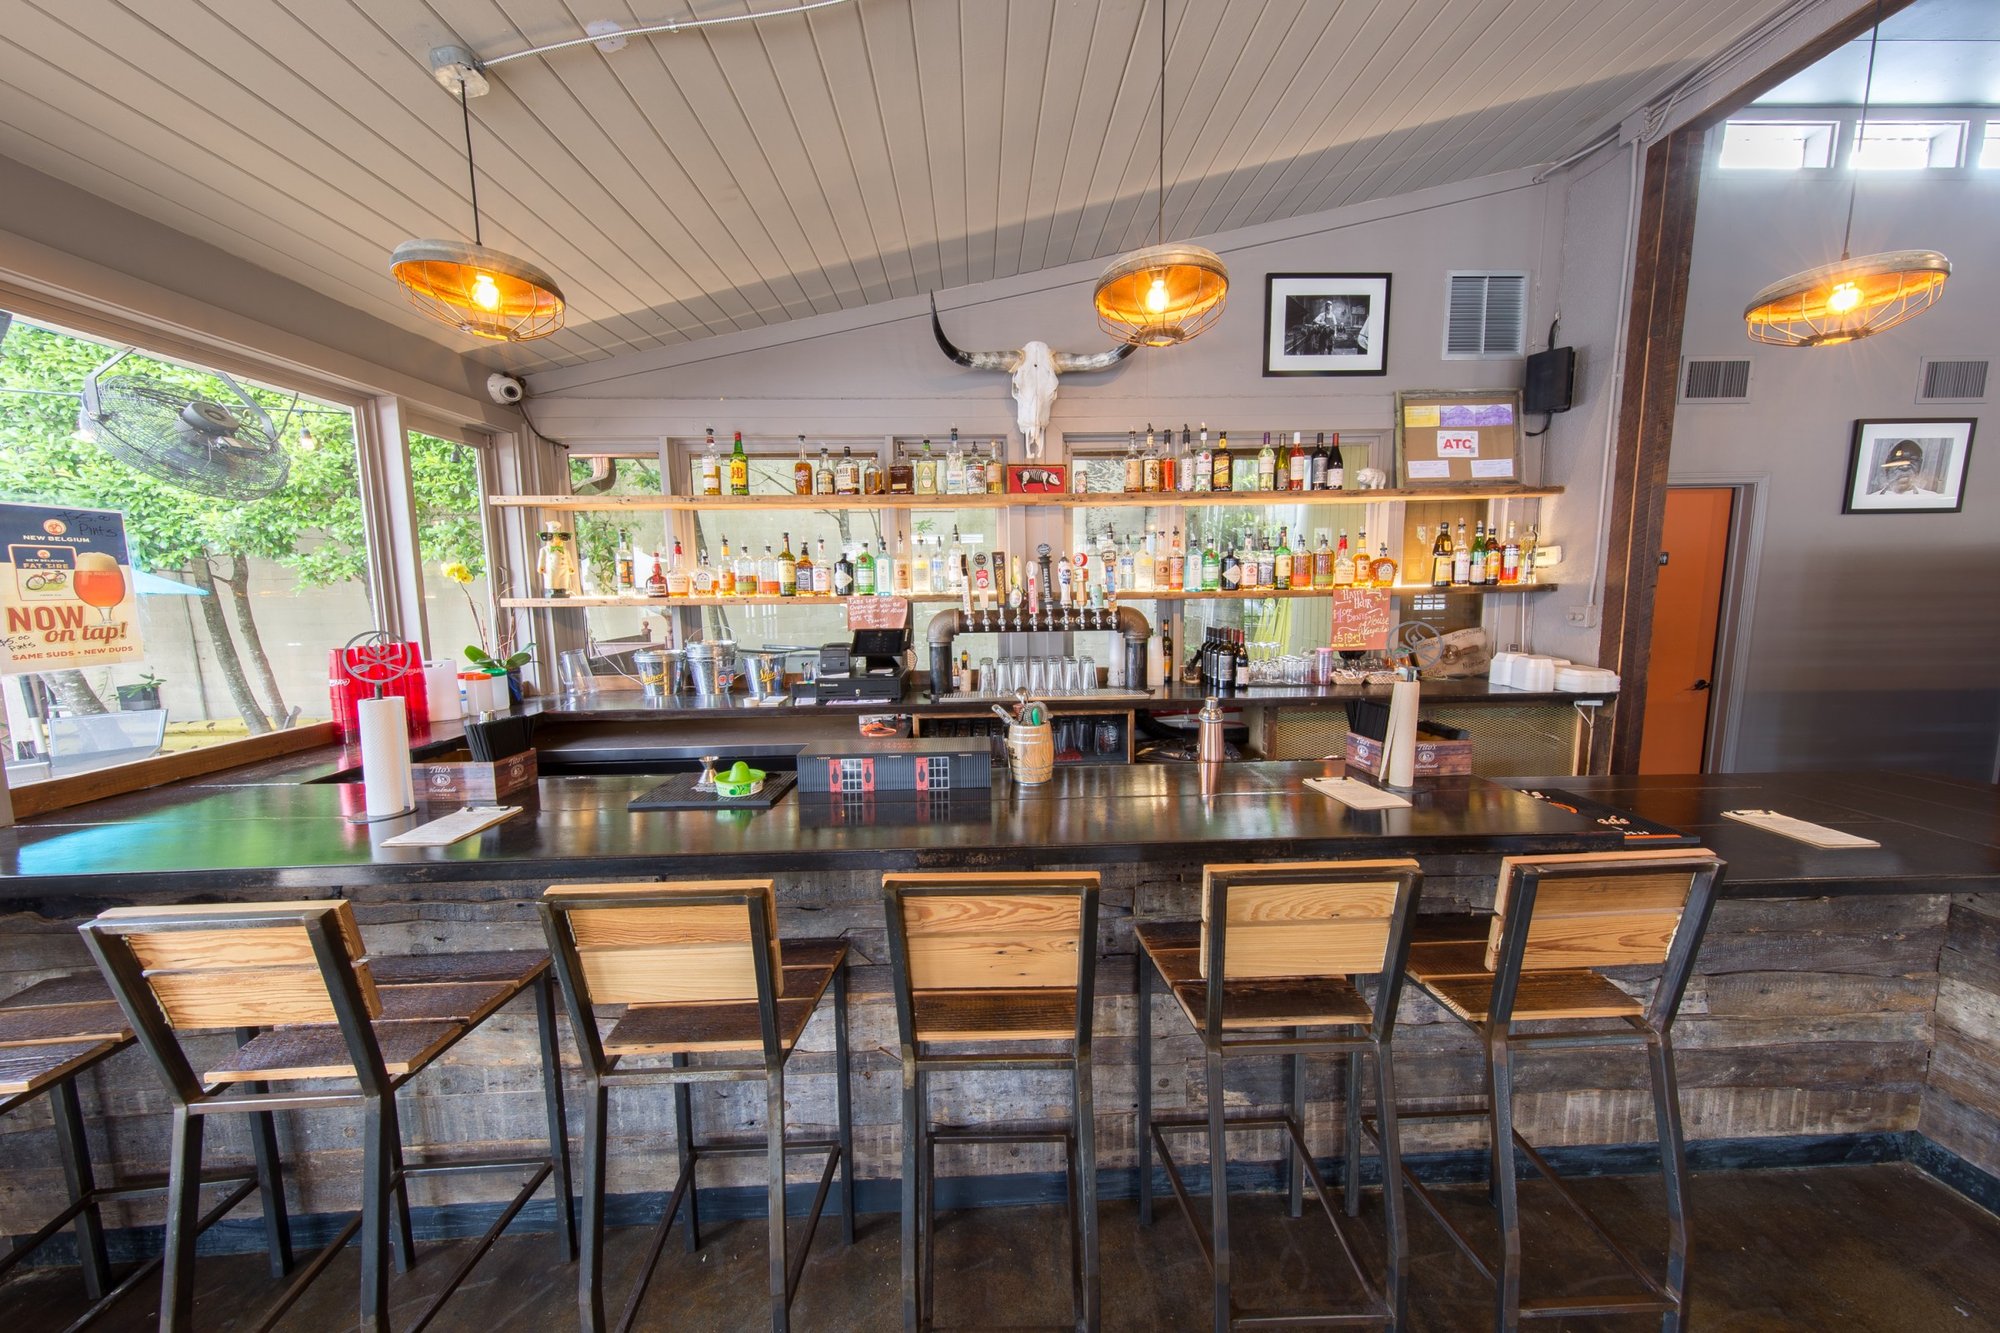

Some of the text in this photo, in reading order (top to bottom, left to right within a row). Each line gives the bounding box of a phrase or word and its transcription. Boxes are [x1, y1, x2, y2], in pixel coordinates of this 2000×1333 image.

[1443, 439, 1472, 449] ATC
[79, 523, 118, 538] Pints
[1354, 597, 1372, 609] HOUR
[7, 606, 84, 632] NOW
[44, 623, 128, 645] on tap!
[9, 643, 36, 652] Pints
[12, 653, 44, 661] SAME
[1356, 737, 1371, 745] Tito's
[429, 766, 451, 774] Tito's
